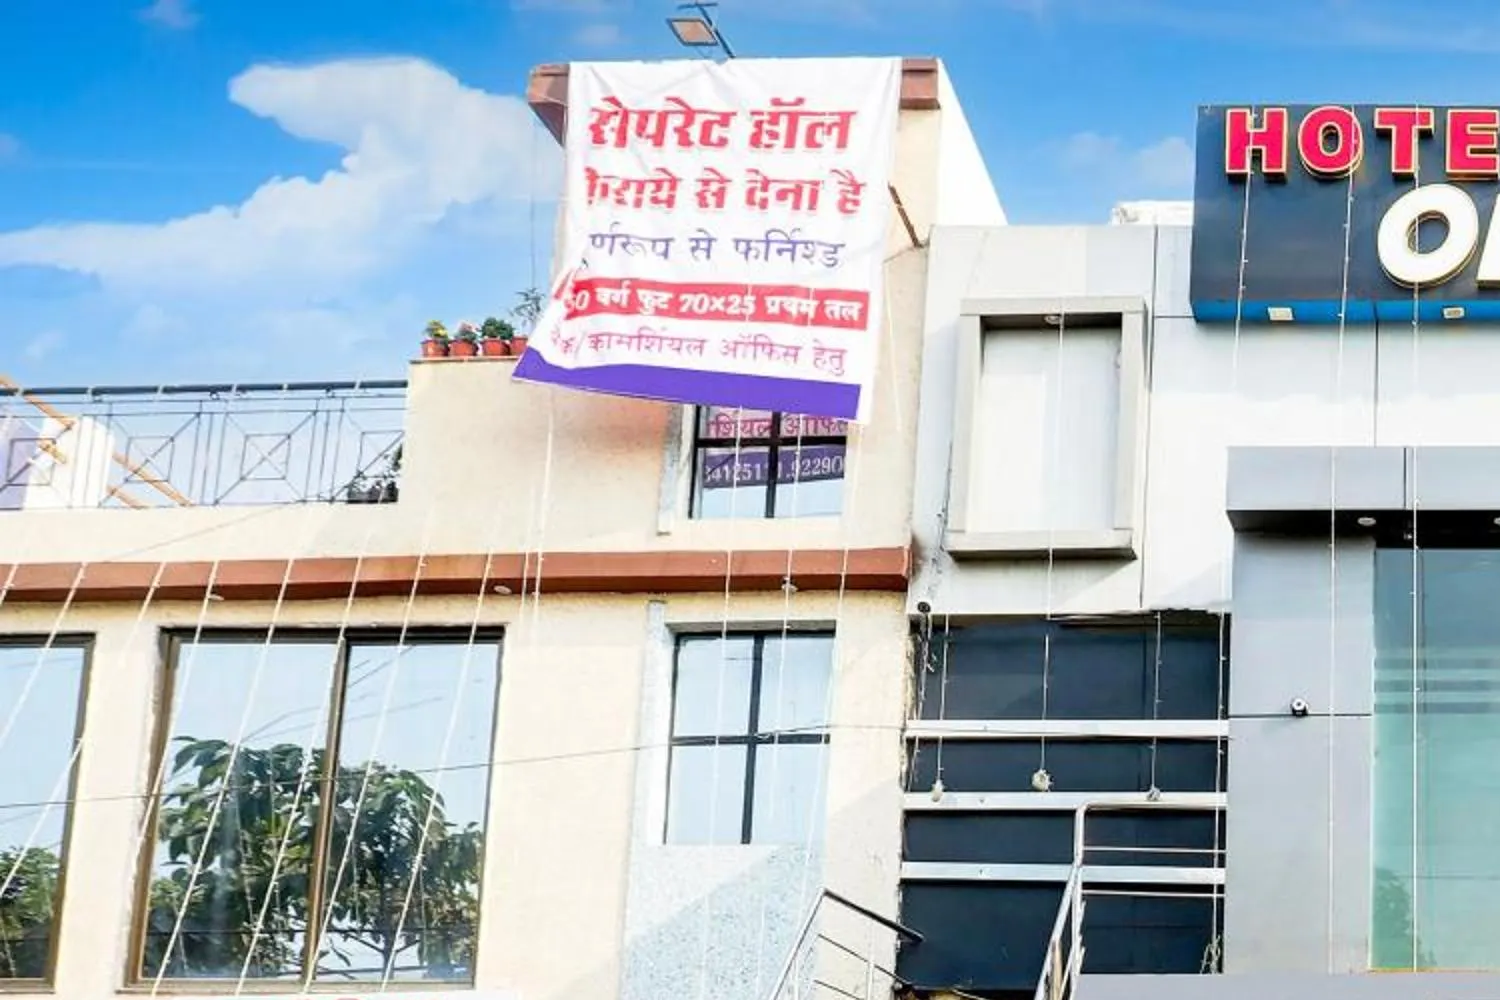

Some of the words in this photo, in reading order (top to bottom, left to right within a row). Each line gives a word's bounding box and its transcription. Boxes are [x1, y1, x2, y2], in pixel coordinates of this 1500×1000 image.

[748, 97, 858, 150] हॉल
[694, 167, 732, 210] से
[744, 168, 826, 213] देना
[831, 168, 866, 215] है
[688, 228, 718, 261] से
